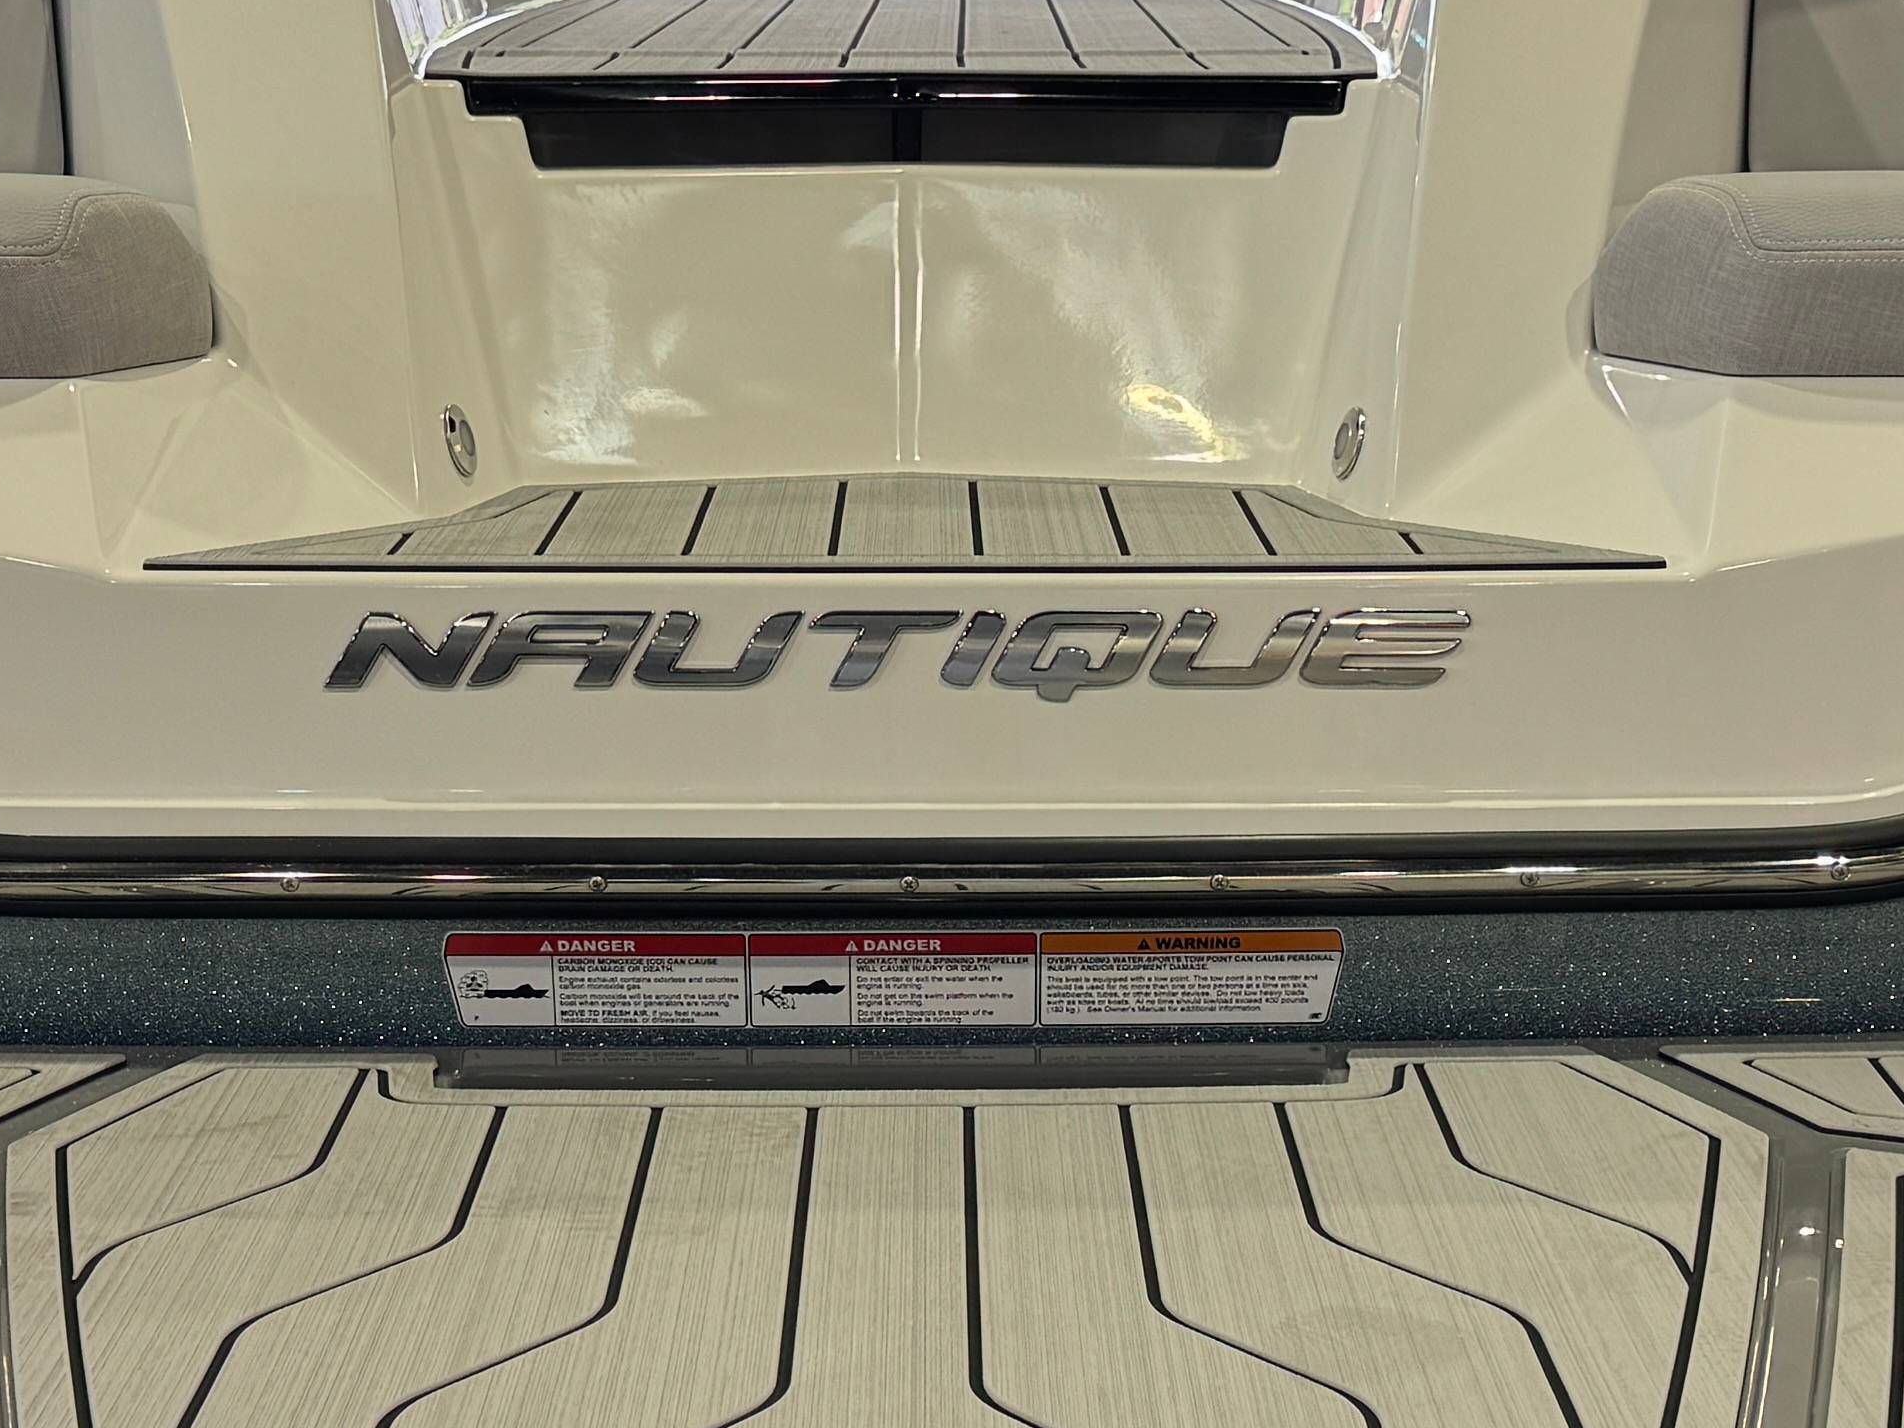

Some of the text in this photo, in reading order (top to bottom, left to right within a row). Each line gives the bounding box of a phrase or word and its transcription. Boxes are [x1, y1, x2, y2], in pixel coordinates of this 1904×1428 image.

[322, 608, 1473, 703] NAUTIQUE
[558, 941, 636, 952] DANGER
[863, 940, 941, 951] DANGER
[1156, 937, 1241, 949] WARNING
